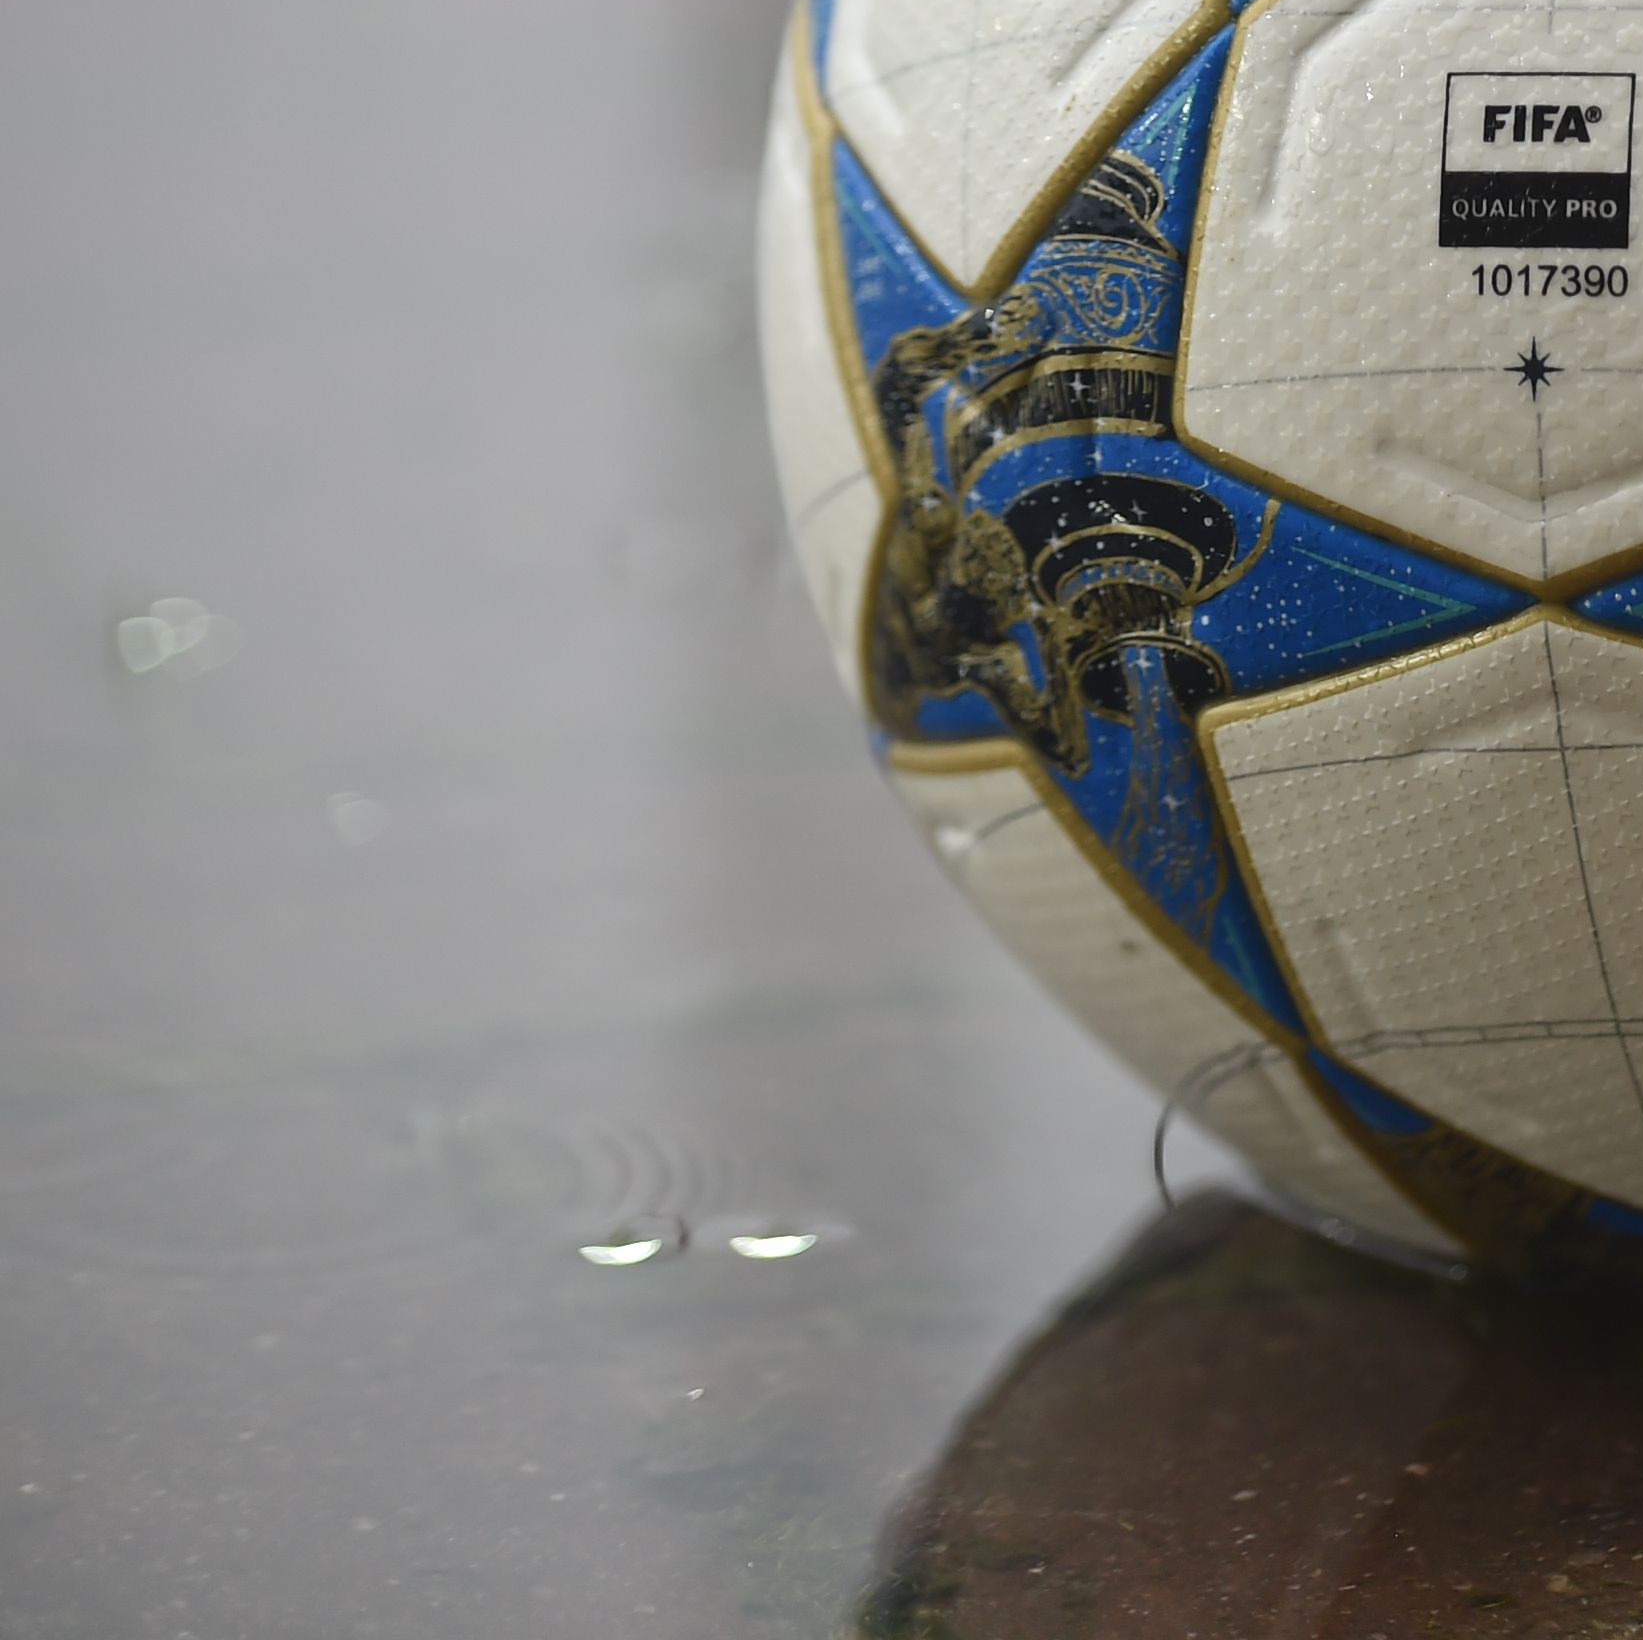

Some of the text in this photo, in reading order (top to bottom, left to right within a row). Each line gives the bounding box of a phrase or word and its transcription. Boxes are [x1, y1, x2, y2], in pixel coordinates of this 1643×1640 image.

[1452, 199, 1617, 220] QUALITY PRO
[1472, 264, 1628, 297] 1017390
